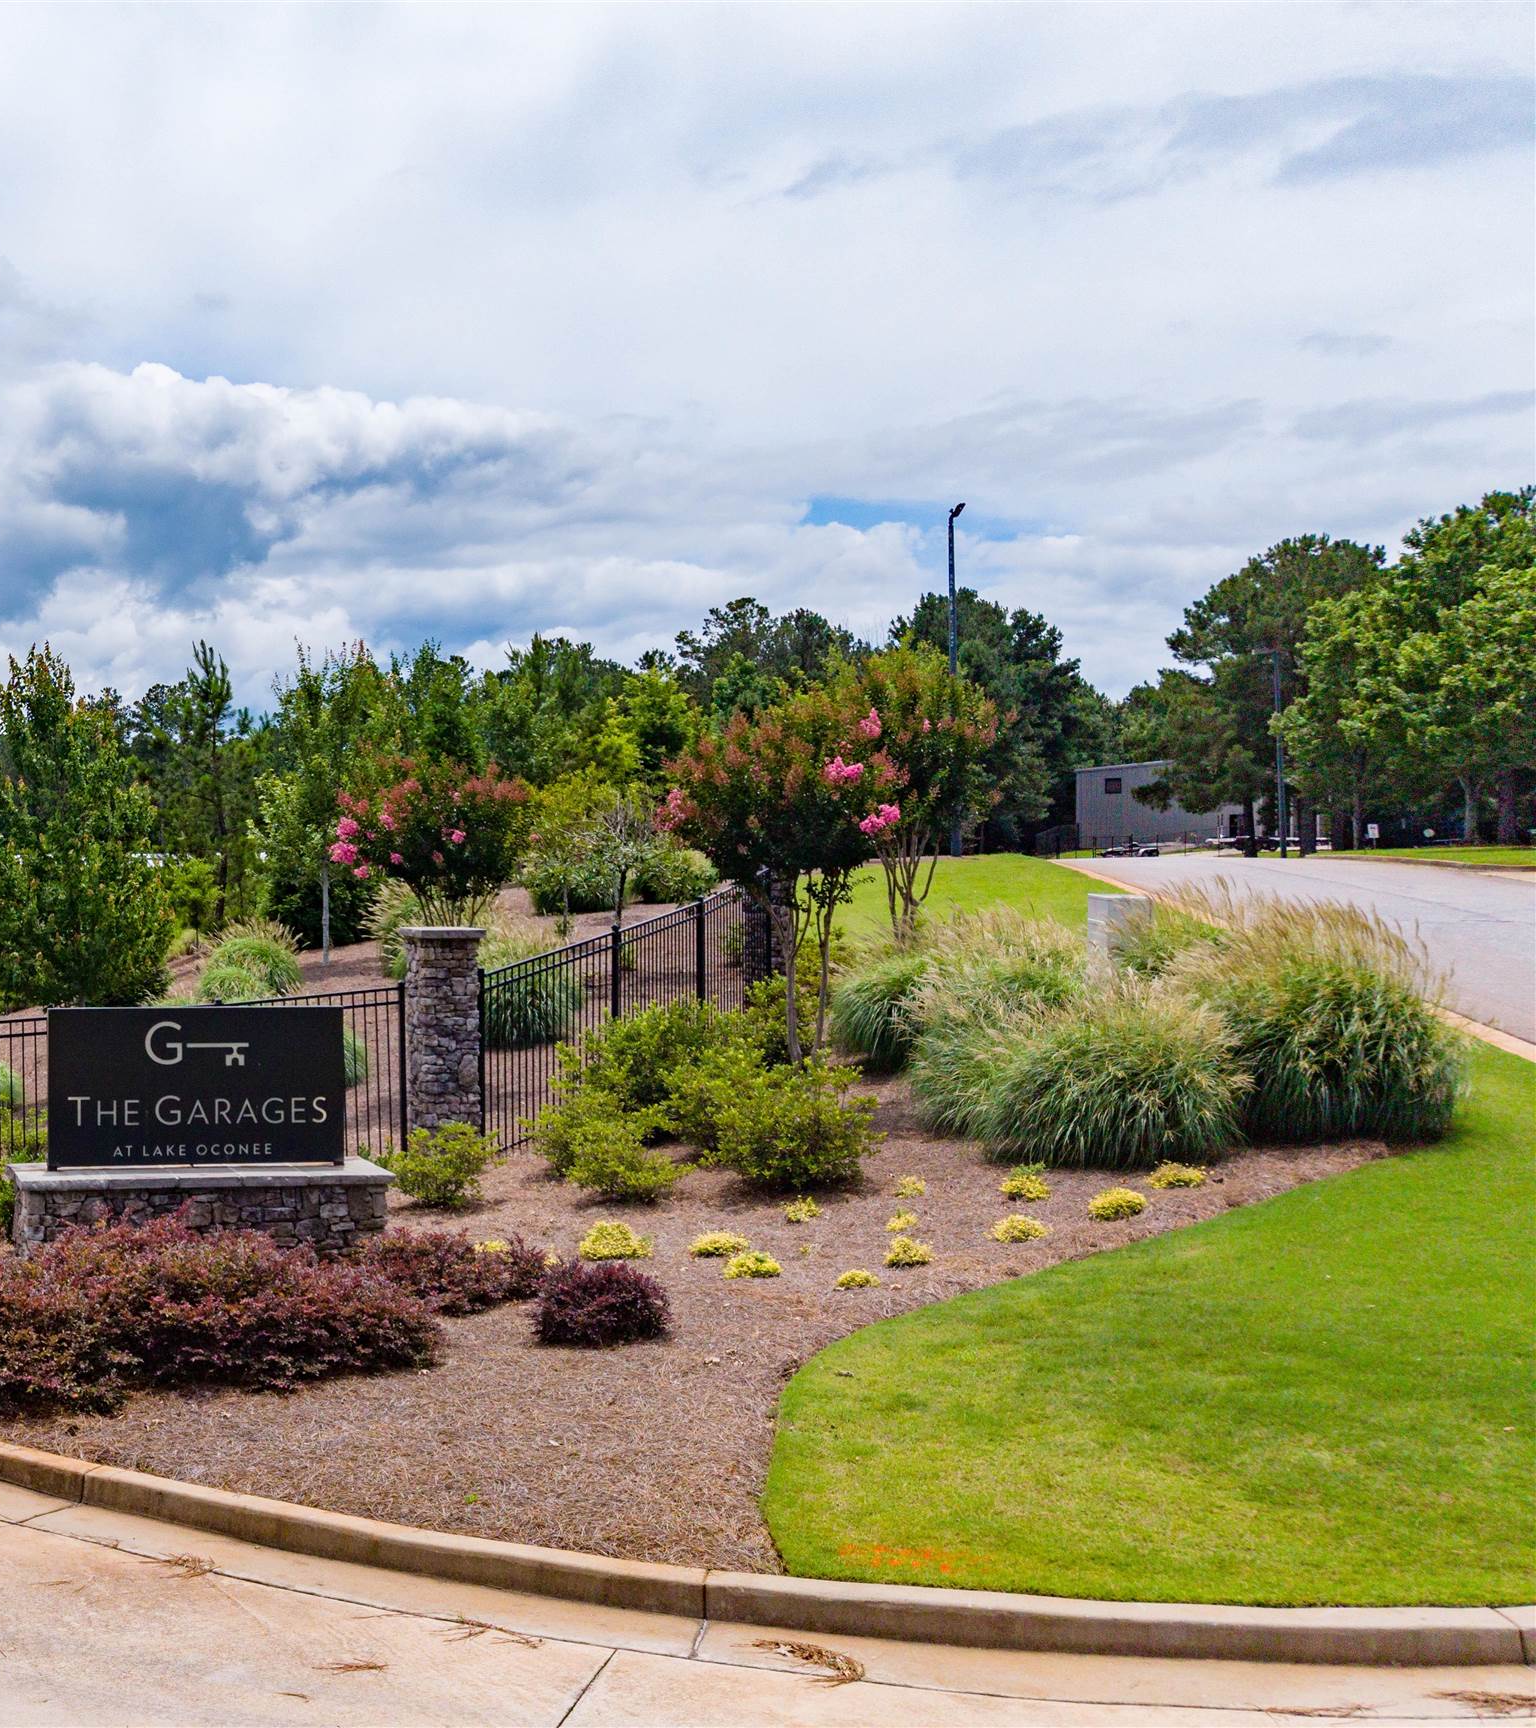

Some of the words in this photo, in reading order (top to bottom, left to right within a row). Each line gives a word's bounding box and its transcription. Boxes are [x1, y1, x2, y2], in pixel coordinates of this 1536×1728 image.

[67, 1096, 140, 1127] THE
[155, 1095, 328, 1126] GARAGES
[113, 1145, 133, 1158] AT
[142, 1144, 187, 1157] LAKE
[196, 1143, 273, 1156] OCONEE
